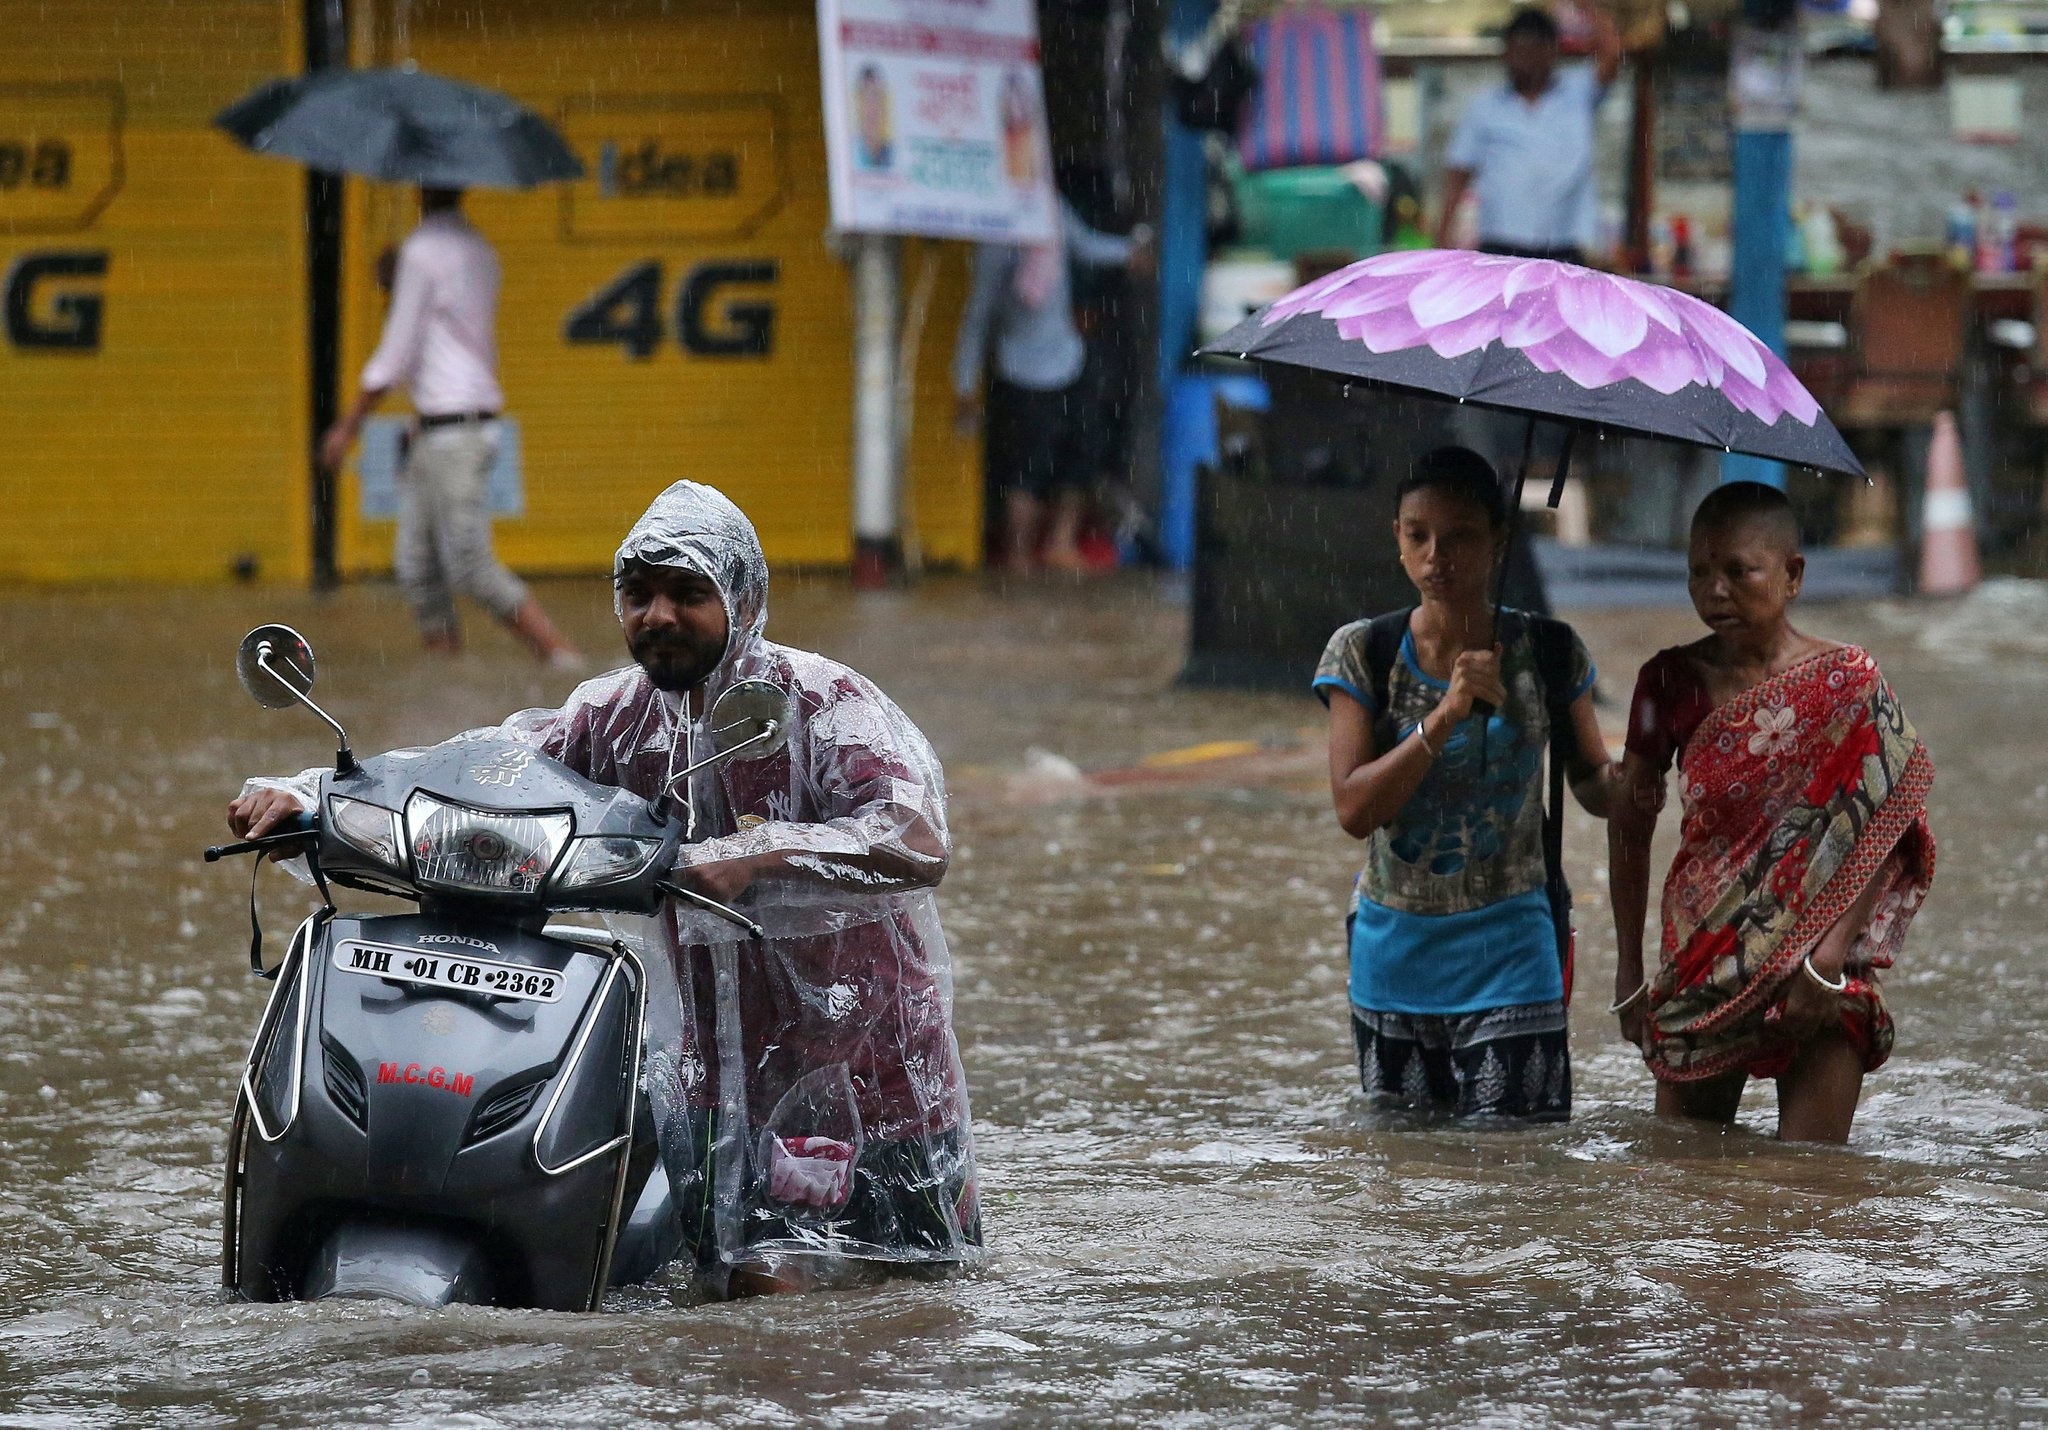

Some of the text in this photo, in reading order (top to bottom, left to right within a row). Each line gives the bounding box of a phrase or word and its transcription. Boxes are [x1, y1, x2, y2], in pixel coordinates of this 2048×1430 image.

[562, 258, 779, 363] 4G
[417, 934, 501, 954] HONDA
[349, 948, 555, 998] MH 01 CB 2362
[377, 1062, 475, 1097] M.C.G.M
